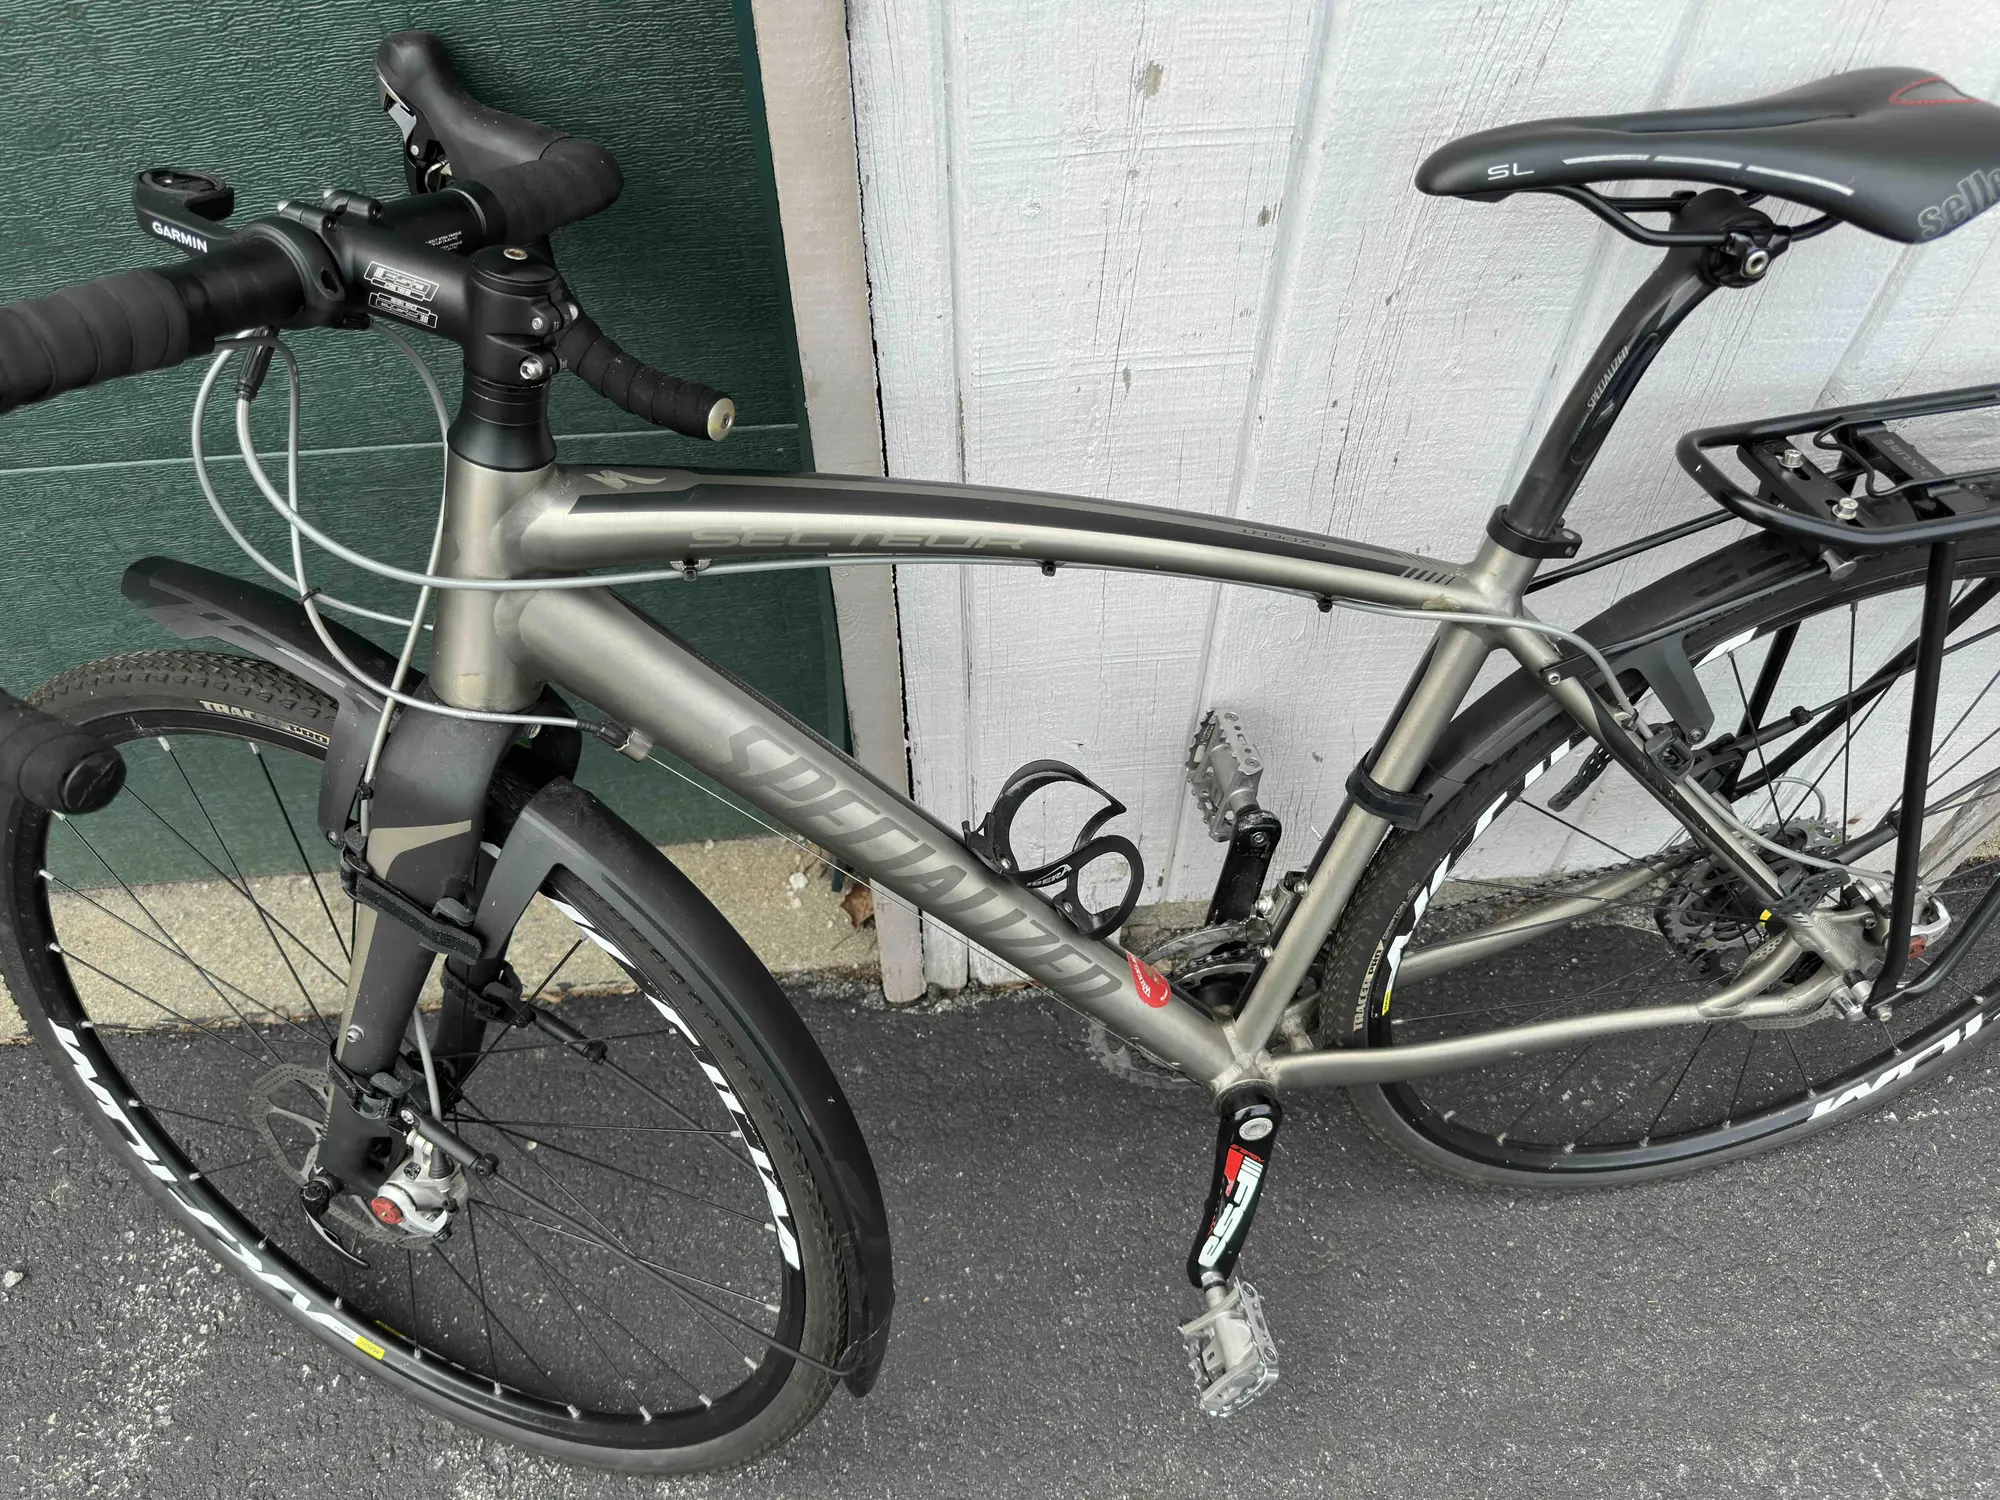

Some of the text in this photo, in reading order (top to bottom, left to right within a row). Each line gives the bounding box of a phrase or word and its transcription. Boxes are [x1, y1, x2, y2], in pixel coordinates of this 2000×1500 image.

[1488, 163, 1534, 180] SL
[152, 221, 208, 253] GARMIN
[1587, 345, 1629, 410] SPECIALIZED
[689, 526, 1031, 550] SECTEUR
[1240, 528, 1326, 548] EXPERT
[718, 724, 1123, 999] SPECIALIZED
[1026, 864, 1072, 887] IBERA
[1353, 977, 1371, 1032] TRACER
